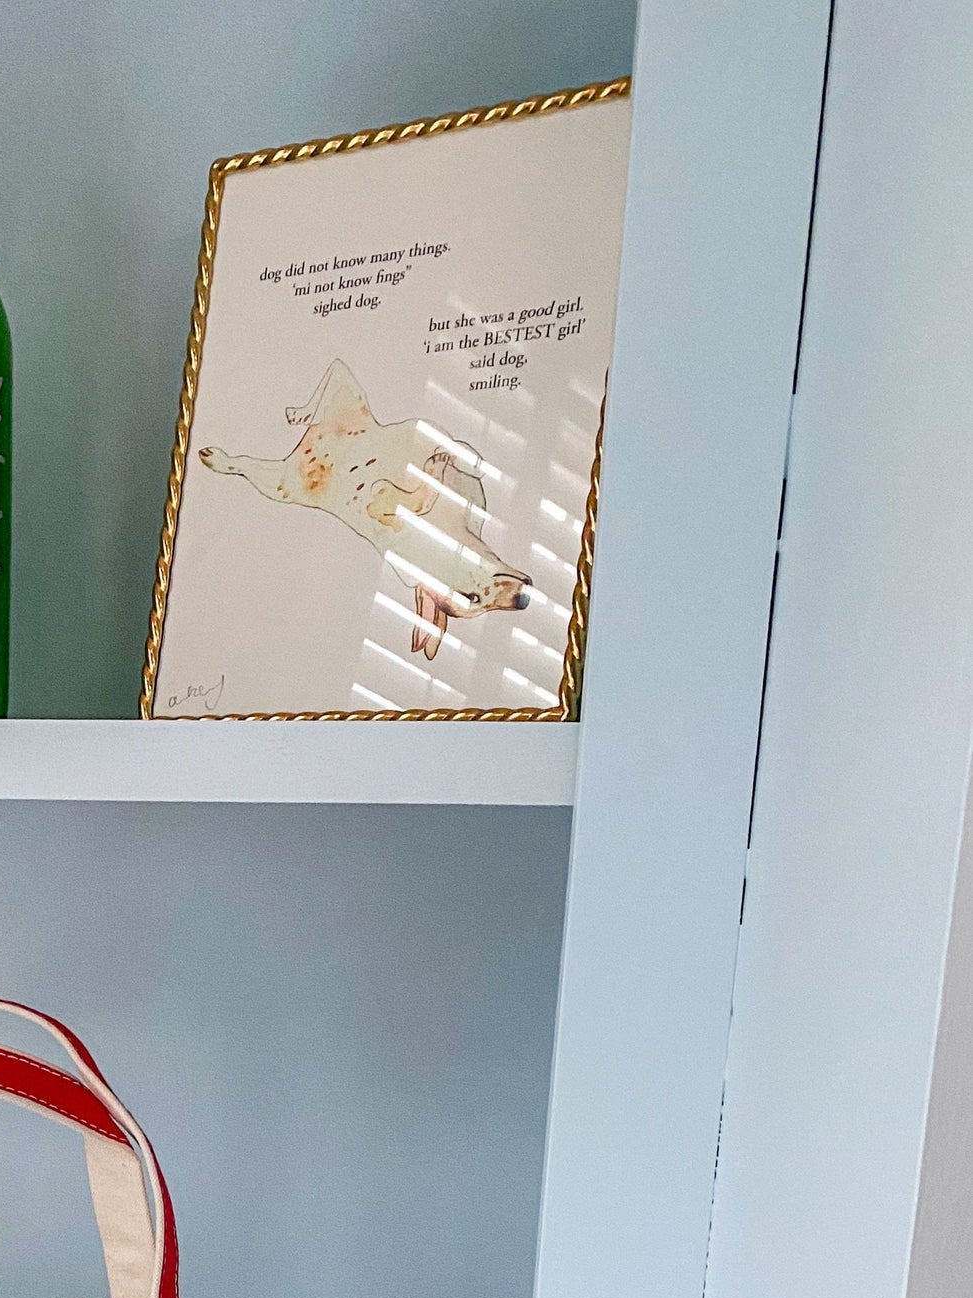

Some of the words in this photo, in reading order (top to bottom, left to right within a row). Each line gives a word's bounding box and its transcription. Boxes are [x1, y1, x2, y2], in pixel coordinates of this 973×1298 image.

[260, 267, 282, 283] dog
[285, 261, 306, 277] did
[309, 262, 329, 273] not
[333, 256, 367, 270] know
[370, 249, 405, 264] many
[409, 241, 451, 258] things.
[315, 281, 334, 294] not
[338, 276, 373, 290] know
[313, 295, 352, 317] sighed
[429, 318, 451, 332] but
[454, 313, 476, 329] she
[480, 314, 504, 324] was
[507, 311, 515, 321] a
[518, 300, 556, 325] good
[556, 296, 584, 319] girl.
[434, 342, 454, 353] am
[459, 334, 480, 349] the
[483, 323, 556, 346] BESTEST
[469, 352, 496, 370] said
[469, 374, 521, 391] smiling.
